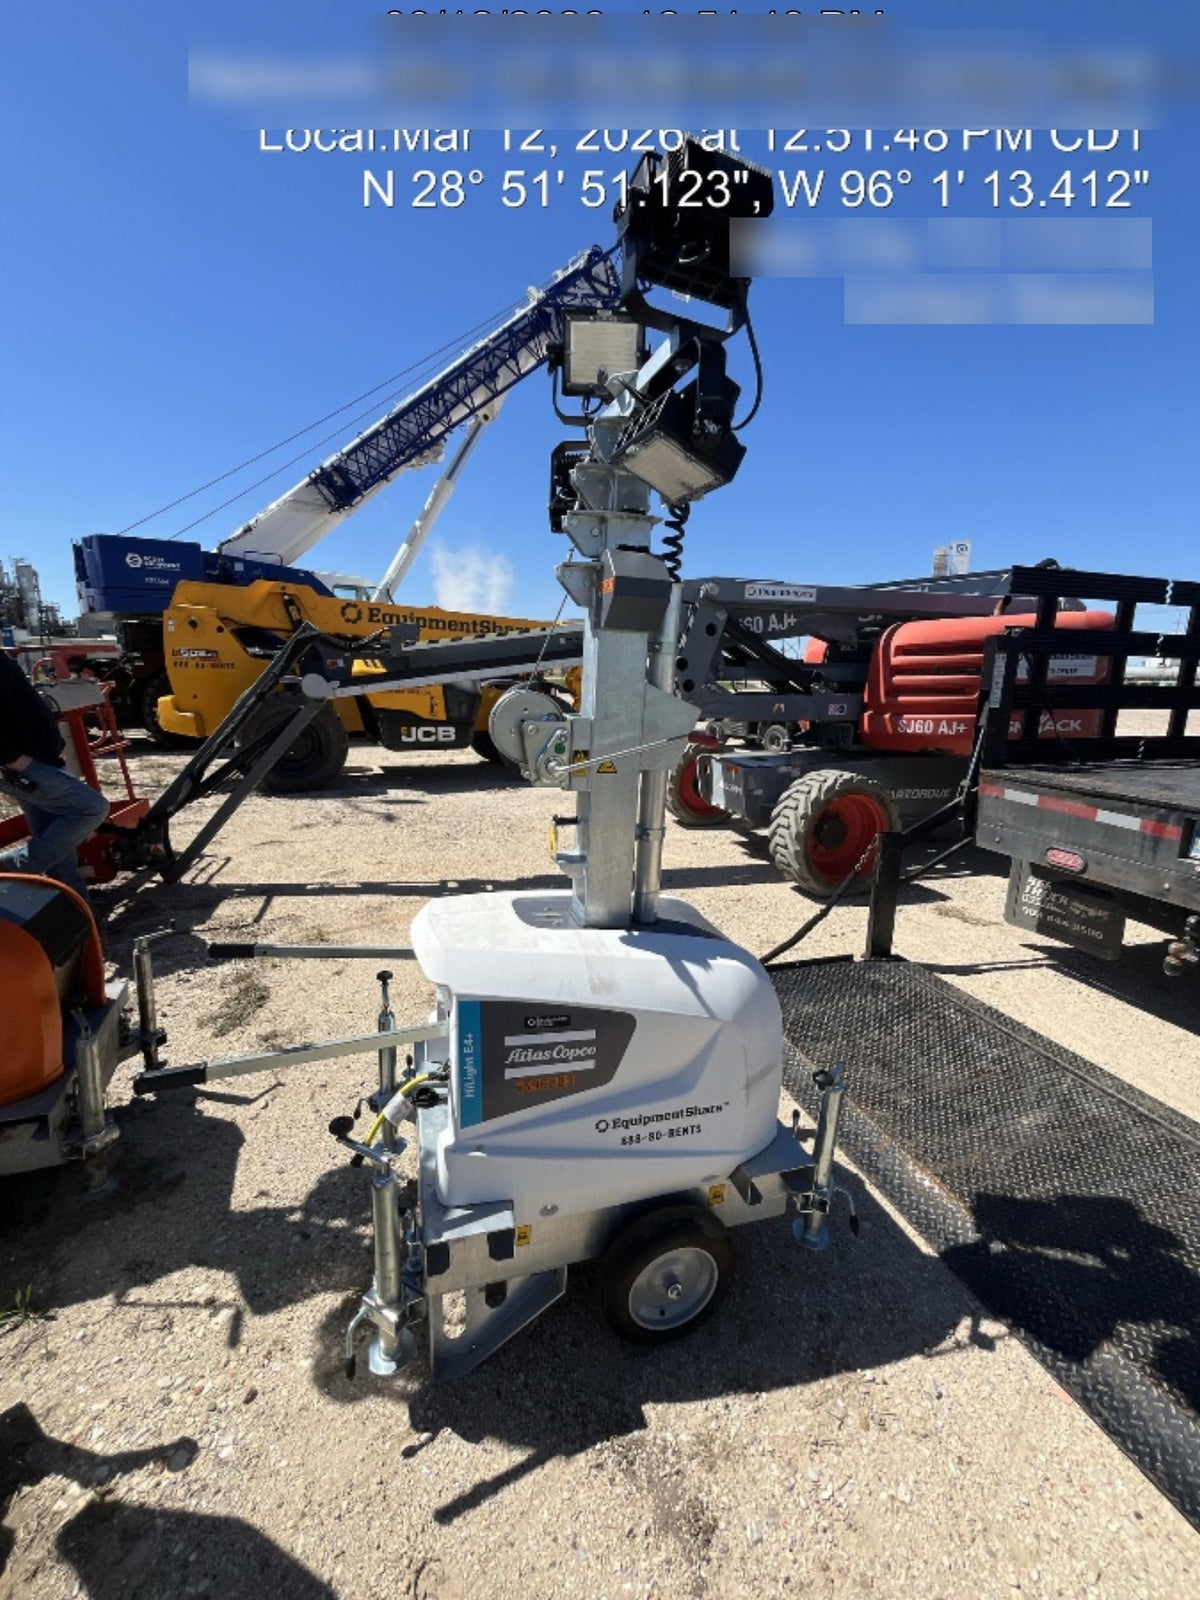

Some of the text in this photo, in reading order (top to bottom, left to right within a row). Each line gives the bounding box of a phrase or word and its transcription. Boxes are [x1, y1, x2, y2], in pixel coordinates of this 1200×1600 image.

[401, 726, 456, 742] JCB
[897, 718, 969, 735] SJ60 AJ+
[505, 1044, 597, 1063] Atlas Copco
